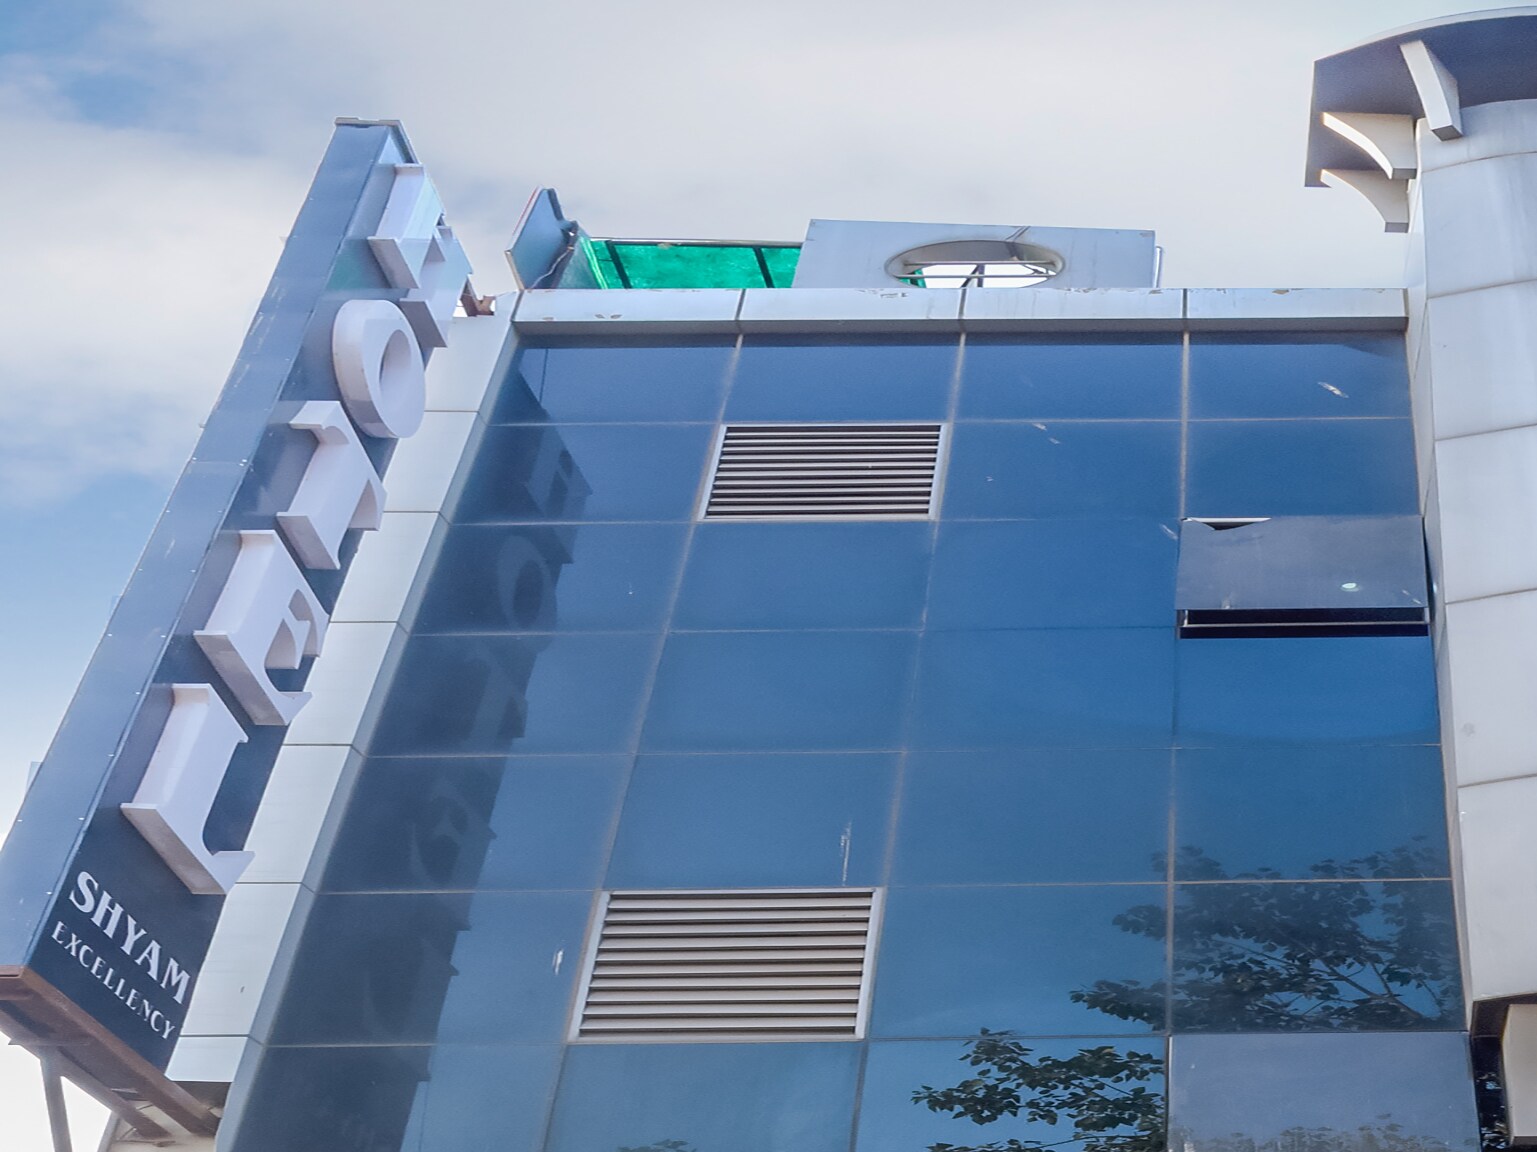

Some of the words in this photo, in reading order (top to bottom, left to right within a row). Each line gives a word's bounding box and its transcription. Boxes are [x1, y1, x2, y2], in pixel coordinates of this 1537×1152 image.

[121, 163, 474, 895] HOTEL
[51, 920, 176, 1040] EXCELLENCY
[69, 871, 191, 1004] SHYAM
